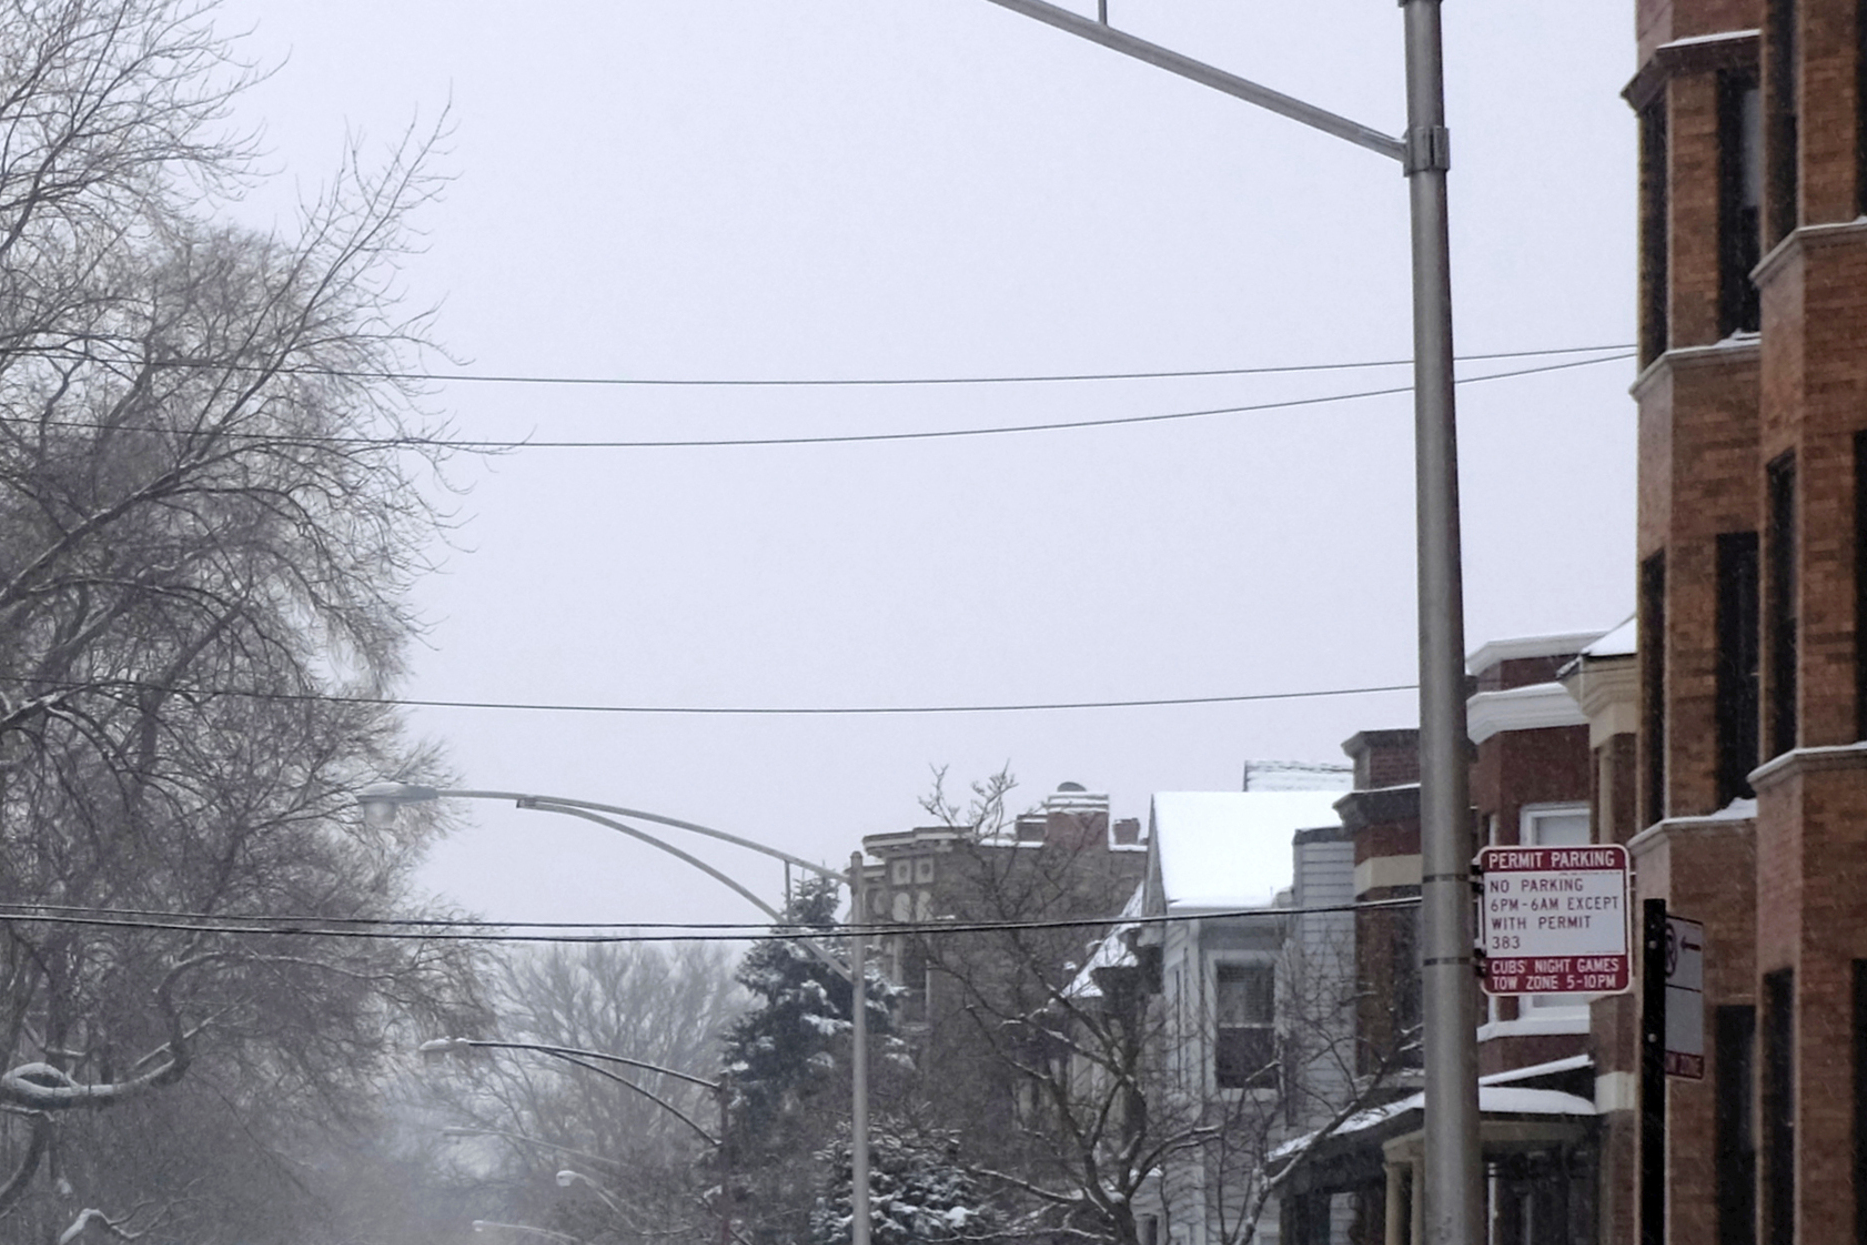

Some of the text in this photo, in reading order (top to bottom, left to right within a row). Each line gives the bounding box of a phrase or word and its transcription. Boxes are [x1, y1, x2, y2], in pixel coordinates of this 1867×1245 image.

[1489, 851, 1615, 869] PERMIT PARKING
[1490, 878, 1583, 893] NO PARKING
[1491, 896, 1618, 911] 6PM-6AM EXCEPT
[1492, 916, 1591, 930] WITH PERMIT
[1492, 936, 1520, 949] 383
[1535, 959, 1570, 972] NIGHT
[1577, 959, 1619, 972] GAMES
[1492, 974, 1616, 989] TOW ZONE 5-10PM
